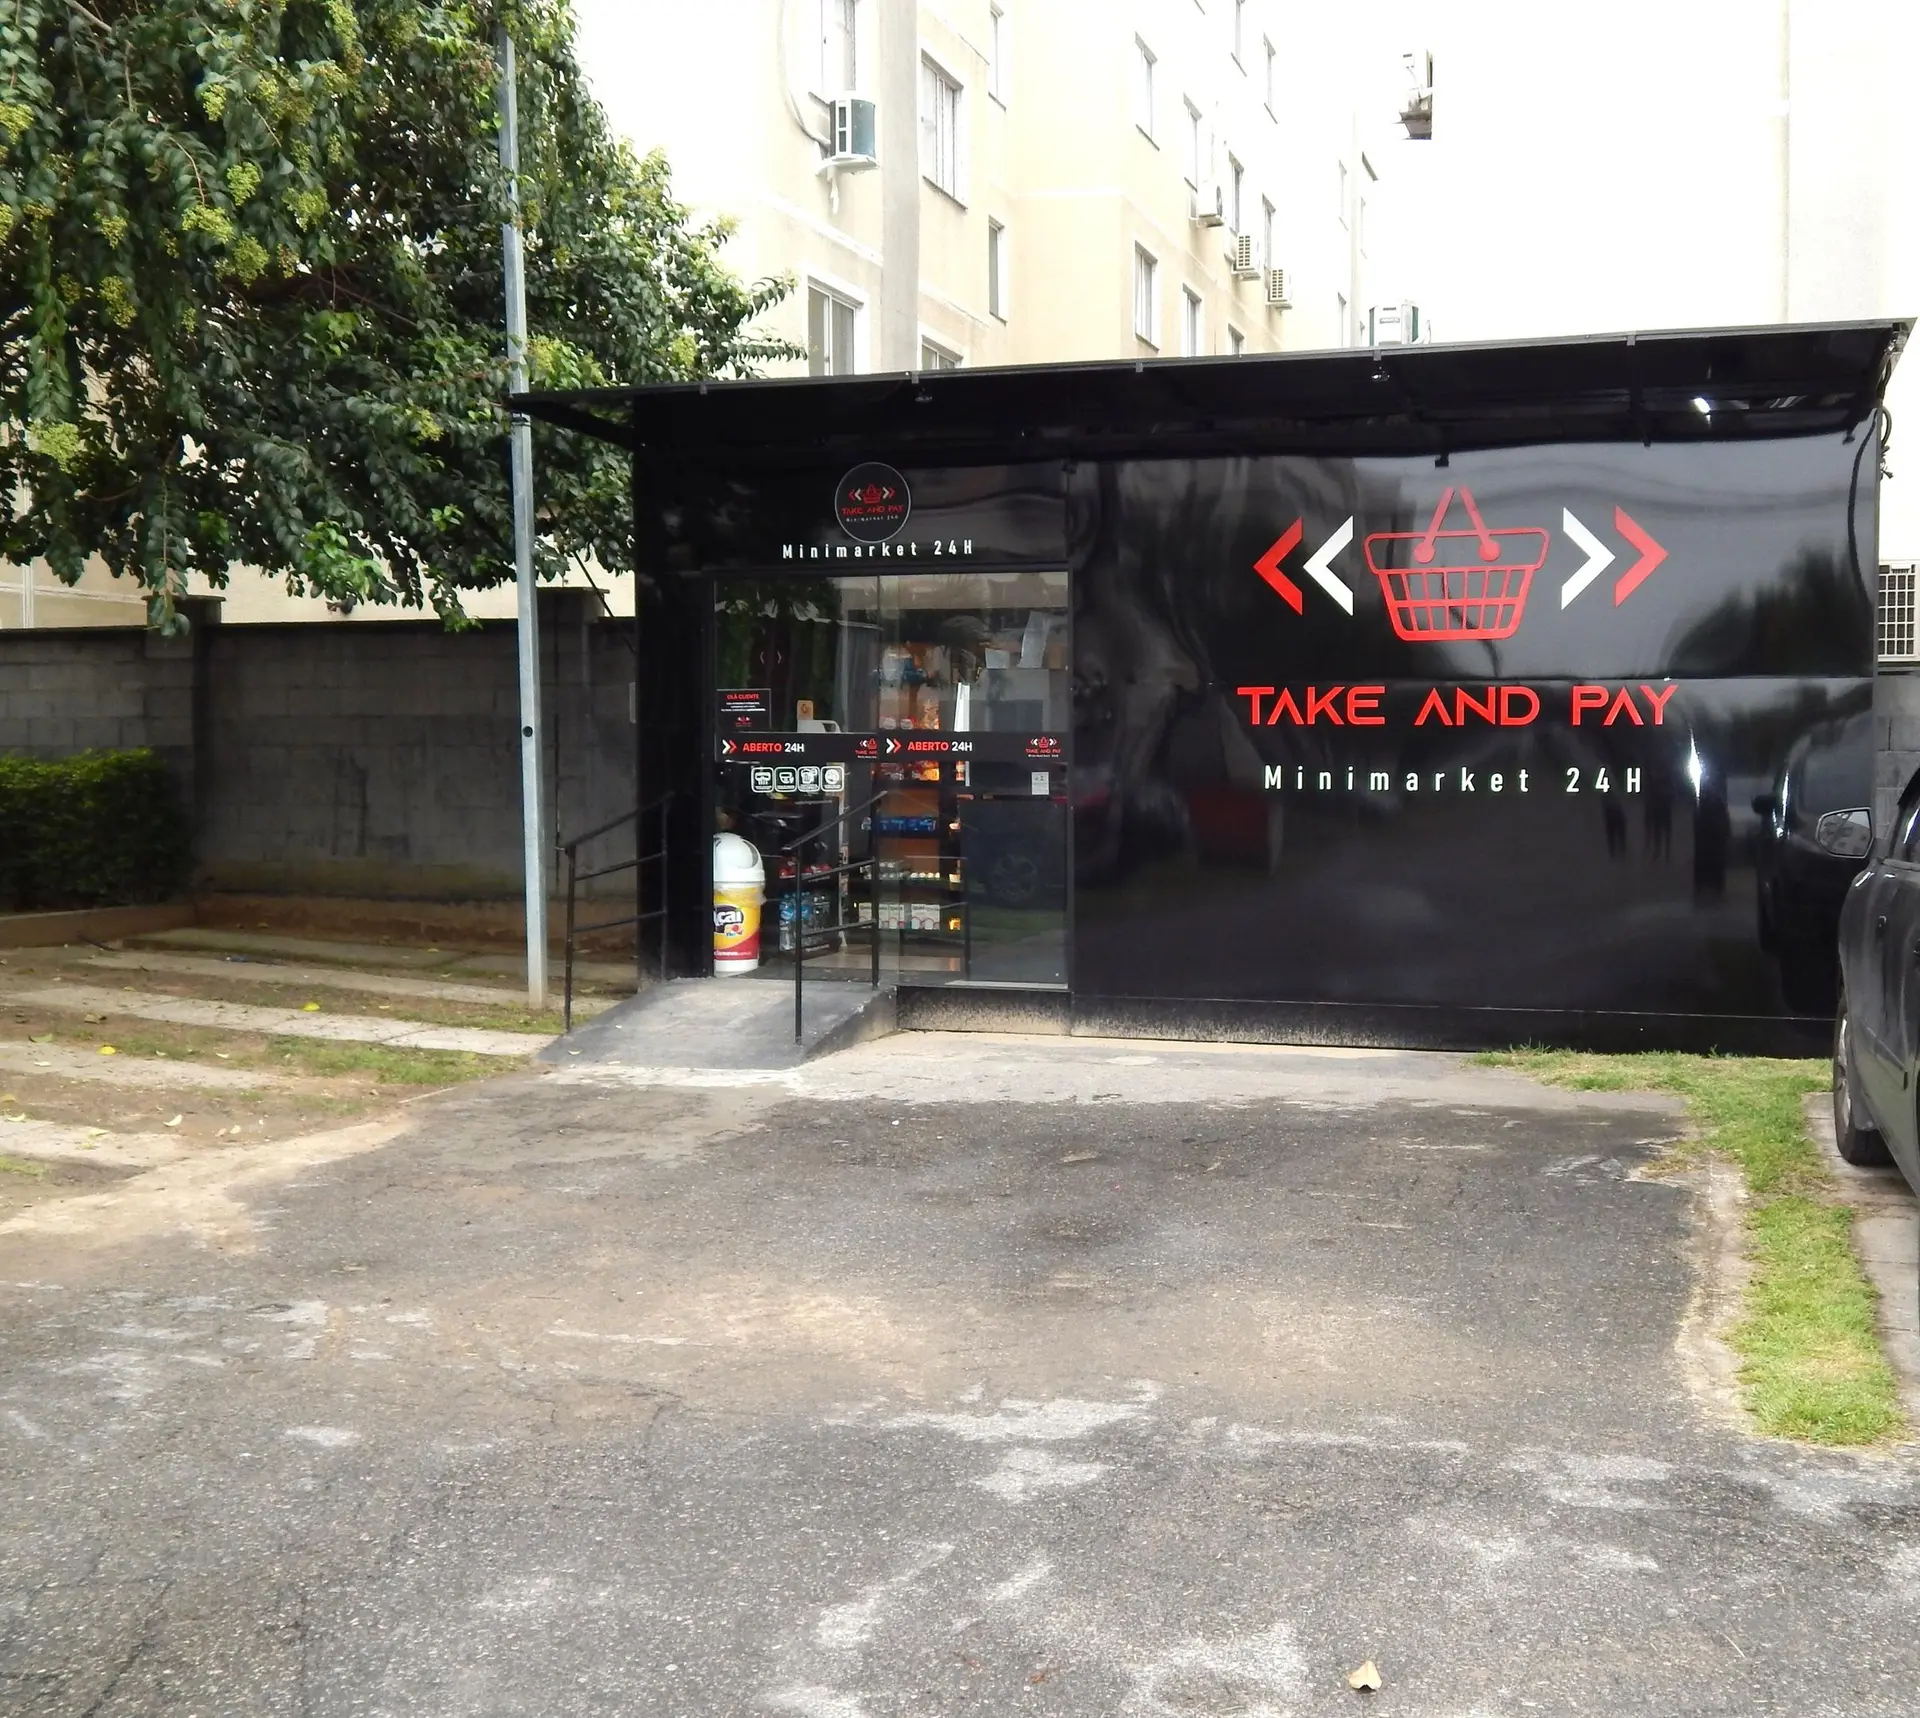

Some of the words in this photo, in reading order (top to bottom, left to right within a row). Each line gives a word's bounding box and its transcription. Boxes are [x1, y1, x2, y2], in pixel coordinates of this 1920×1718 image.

[842, 507, 863, 515] TAKE
[866, 505, 885, 514] AND
[888, 504, 904, 513] PAY
[782, 541, 917, 559] Minimarket
[934, 539, 972, 555] 24H
[1236, 686, 1386, 726] TAKE
[1414, 686, 1541, 727] AND
[1571, 684, 1679, 727] PAY
[742, 742, 782, 753] ABERTO
[784, 742, 805, 753] 24H
[907, 741, 949, 752] ABERTO
[951, 741, 973, 752] 24H
[1264, 764, 1530, 792] Minimarket
[1566, 767, 1642, 793] 24H
